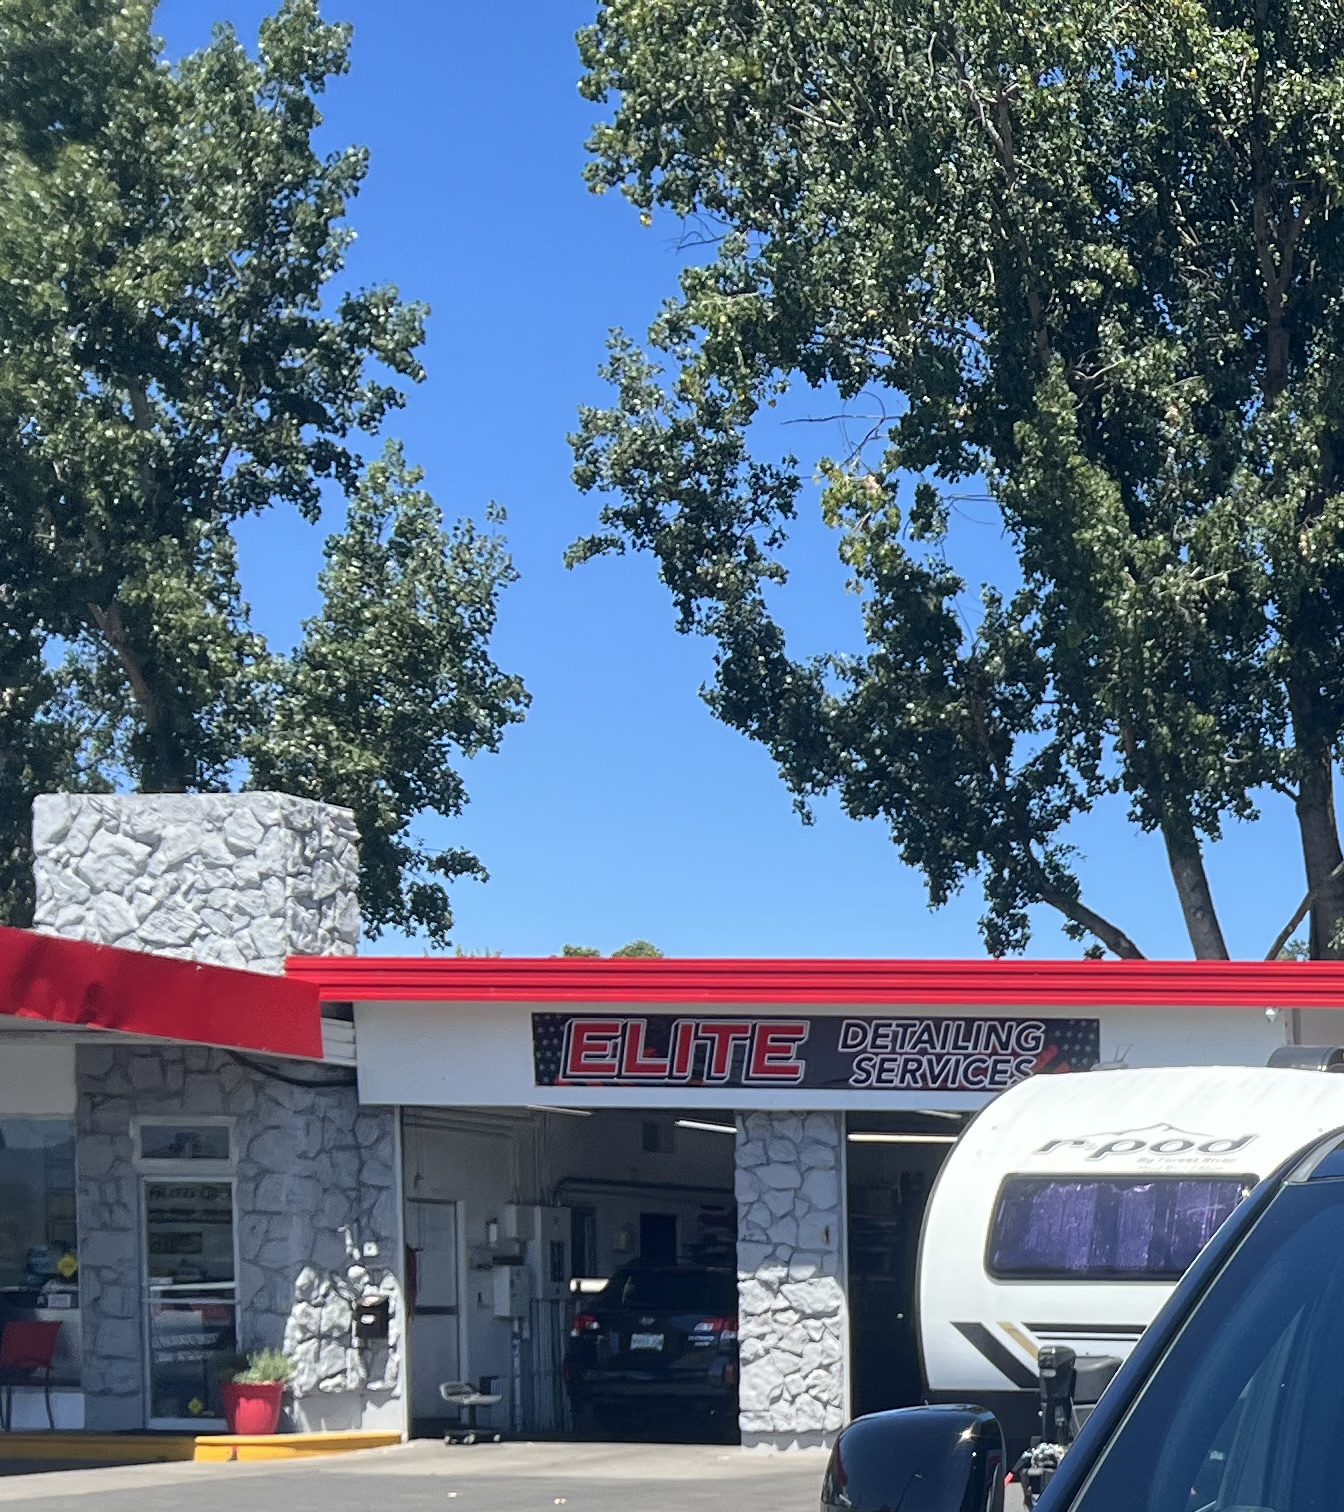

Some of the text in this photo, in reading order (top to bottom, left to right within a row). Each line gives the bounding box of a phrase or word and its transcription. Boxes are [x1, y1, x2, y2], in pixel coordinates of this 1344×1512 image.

[560, 1018, 810, 1085] ELITE
[838, 1020, 1046, 1054] DETAILING
[849, 1054, 1040, 1088] SERVICES
